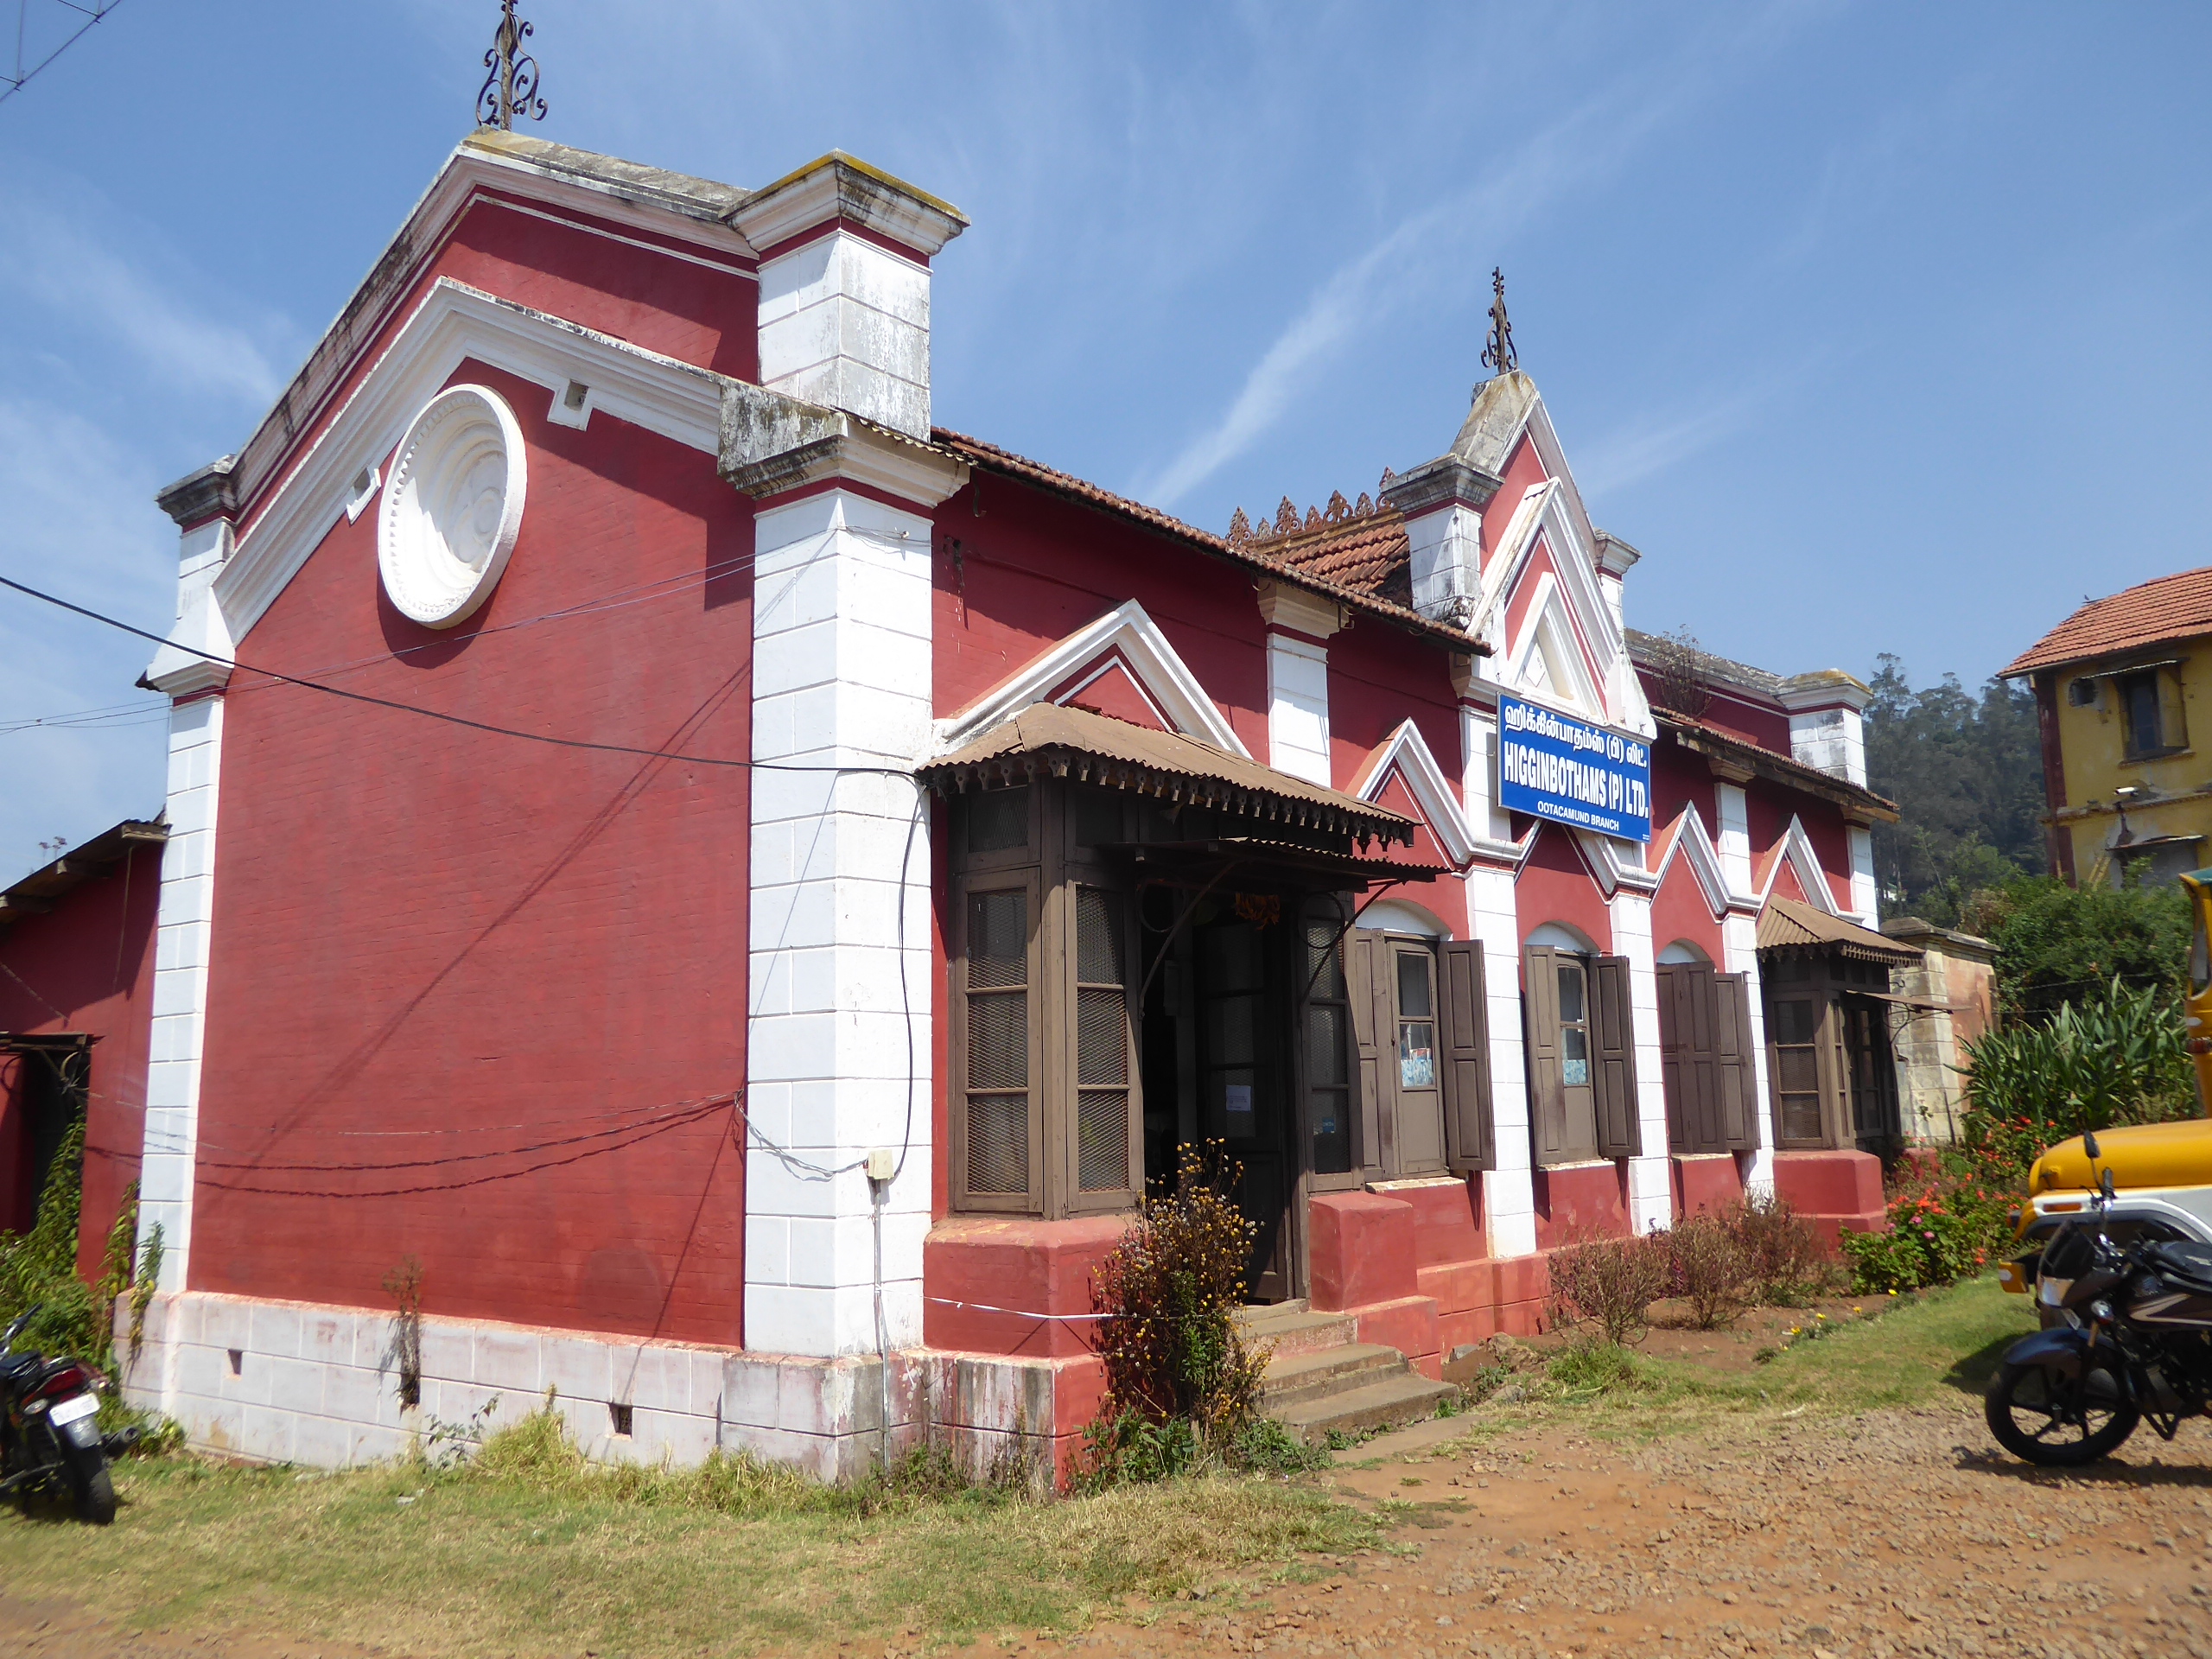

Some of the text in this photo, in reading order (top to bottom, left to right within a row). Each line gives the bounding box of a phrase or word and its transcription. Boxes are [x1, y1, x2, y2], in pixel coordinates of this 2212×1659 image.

[1505, 704, 1605, 753] ஹிக்கின்பாதம்ஸ்
[1606, 734, 1624, 764] (பி)
[1504, 741, 1649, 819] HIGGINBOTHAMS (P) LTD.
[1537, 801, 1619, 831] OOTACAMUND BRANCH
